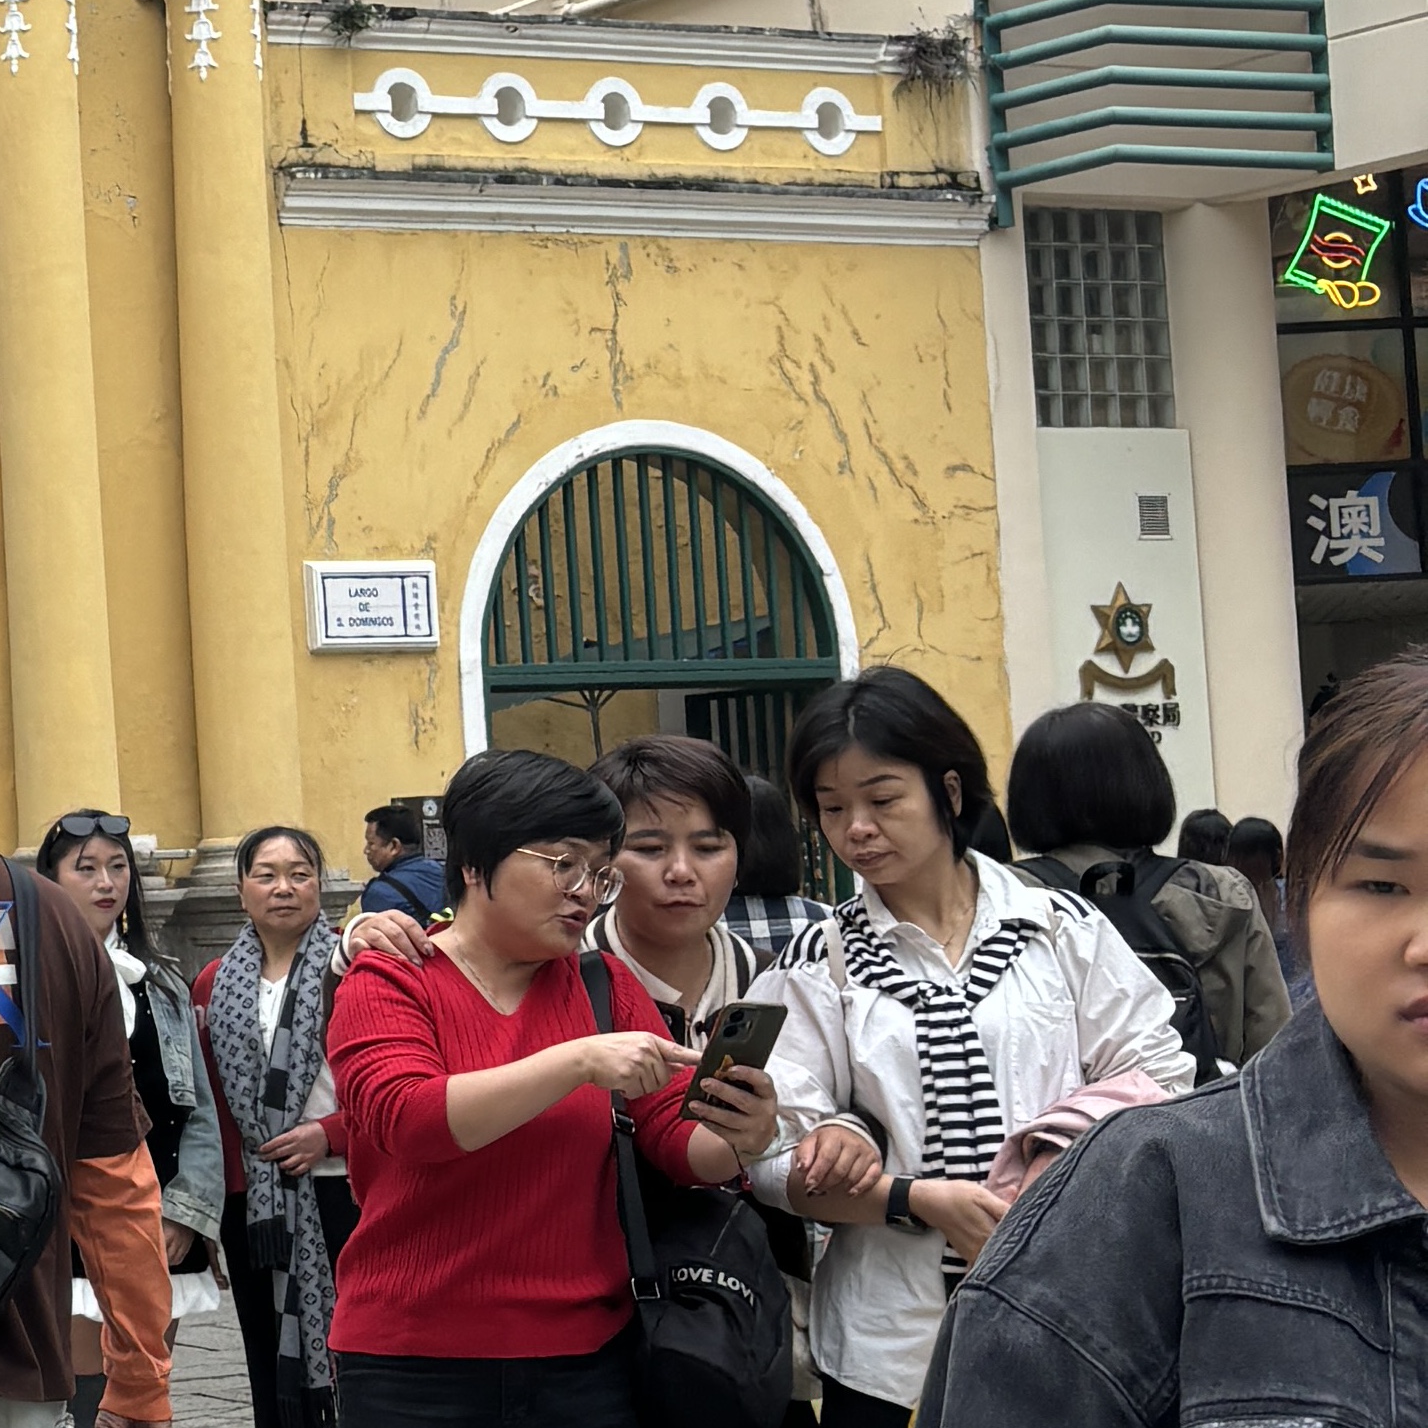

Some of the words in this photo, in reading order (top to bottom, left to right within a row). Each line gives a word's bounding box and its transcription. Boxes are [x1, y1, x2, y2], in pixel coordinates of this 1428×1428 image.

[1306, 490, 1385, 566] 澳
[348, 587, 379, 598] LARGO
[358, 601, 371, 613] DE
[671, 1267, 714, 1283] LOVE
